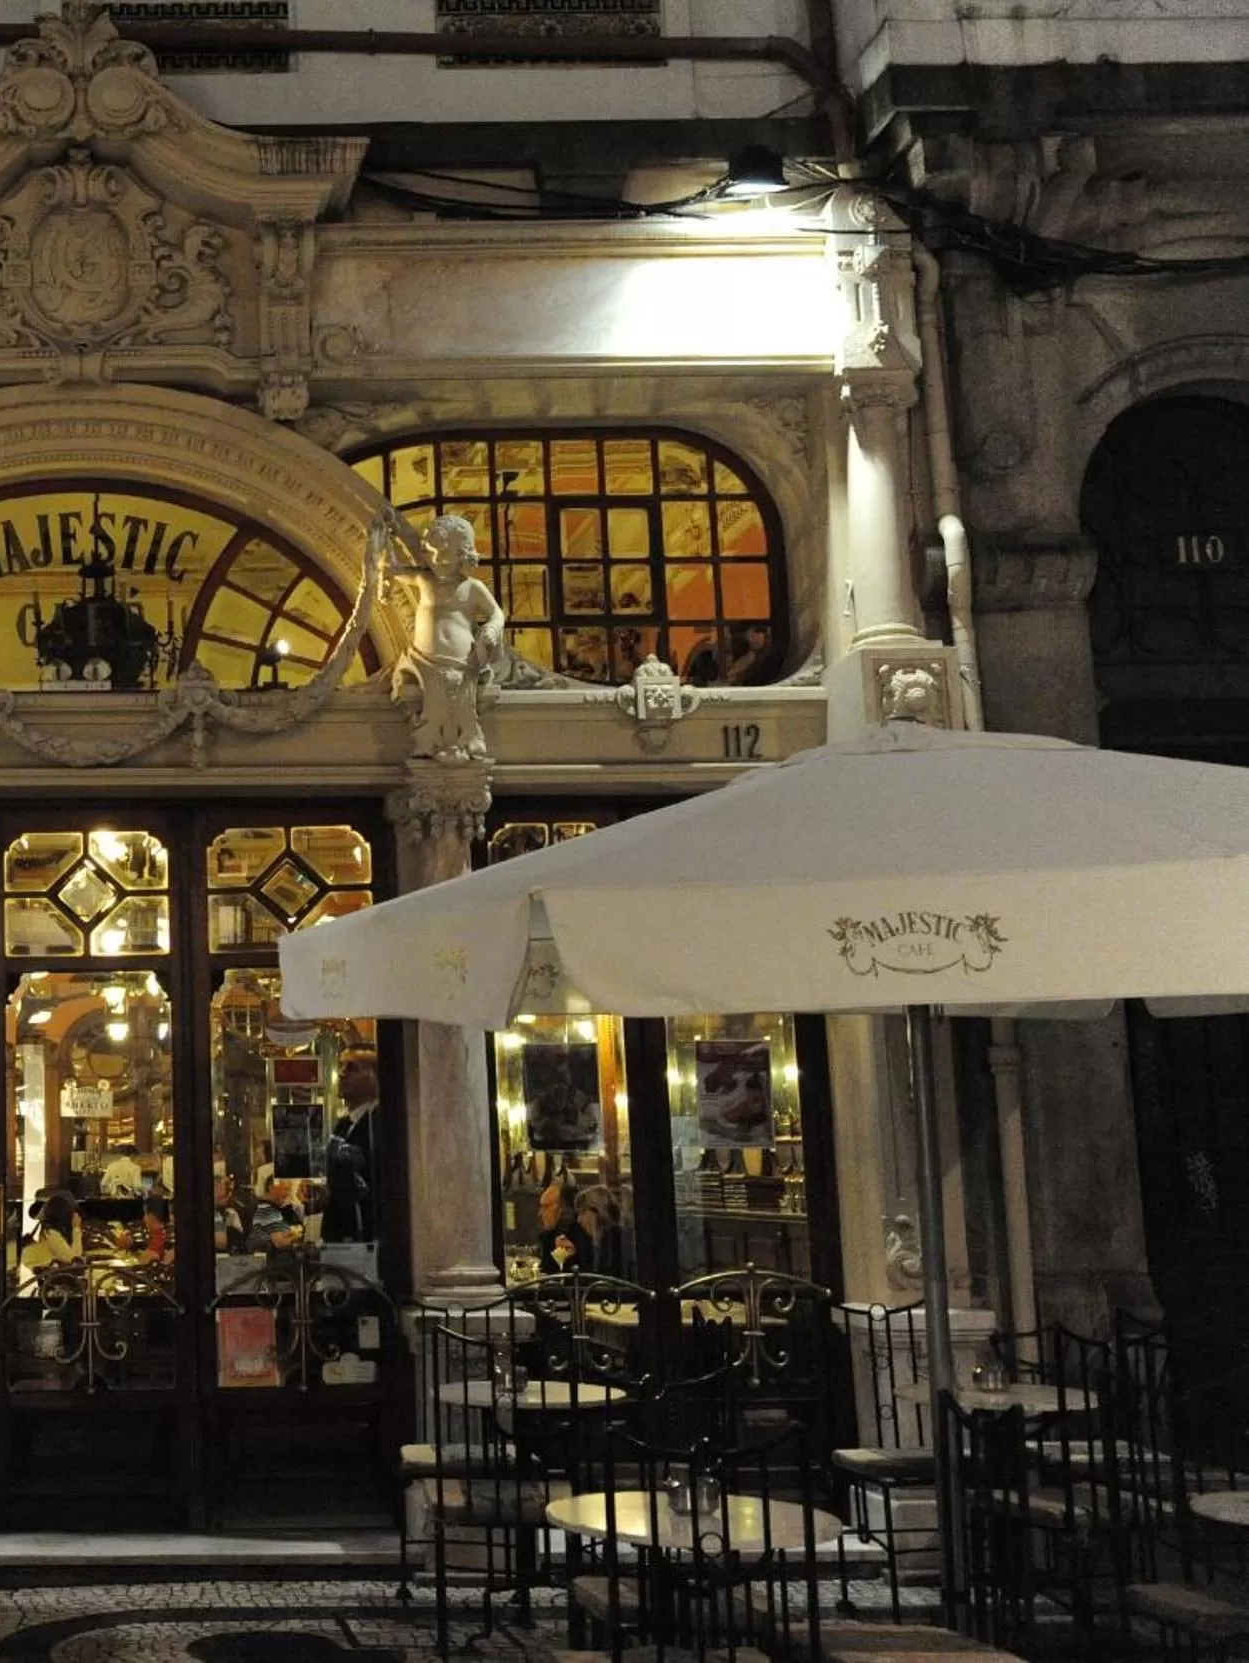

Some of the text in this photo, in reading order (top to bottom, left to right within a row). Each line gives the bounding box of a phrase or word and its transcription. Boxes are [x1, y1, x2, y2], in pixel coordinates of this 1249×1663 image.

[1177, 535, 1224, 564] 110
[721, 724, 763, 759] 112
[862, 911, 966, 946] MAJESTIC
